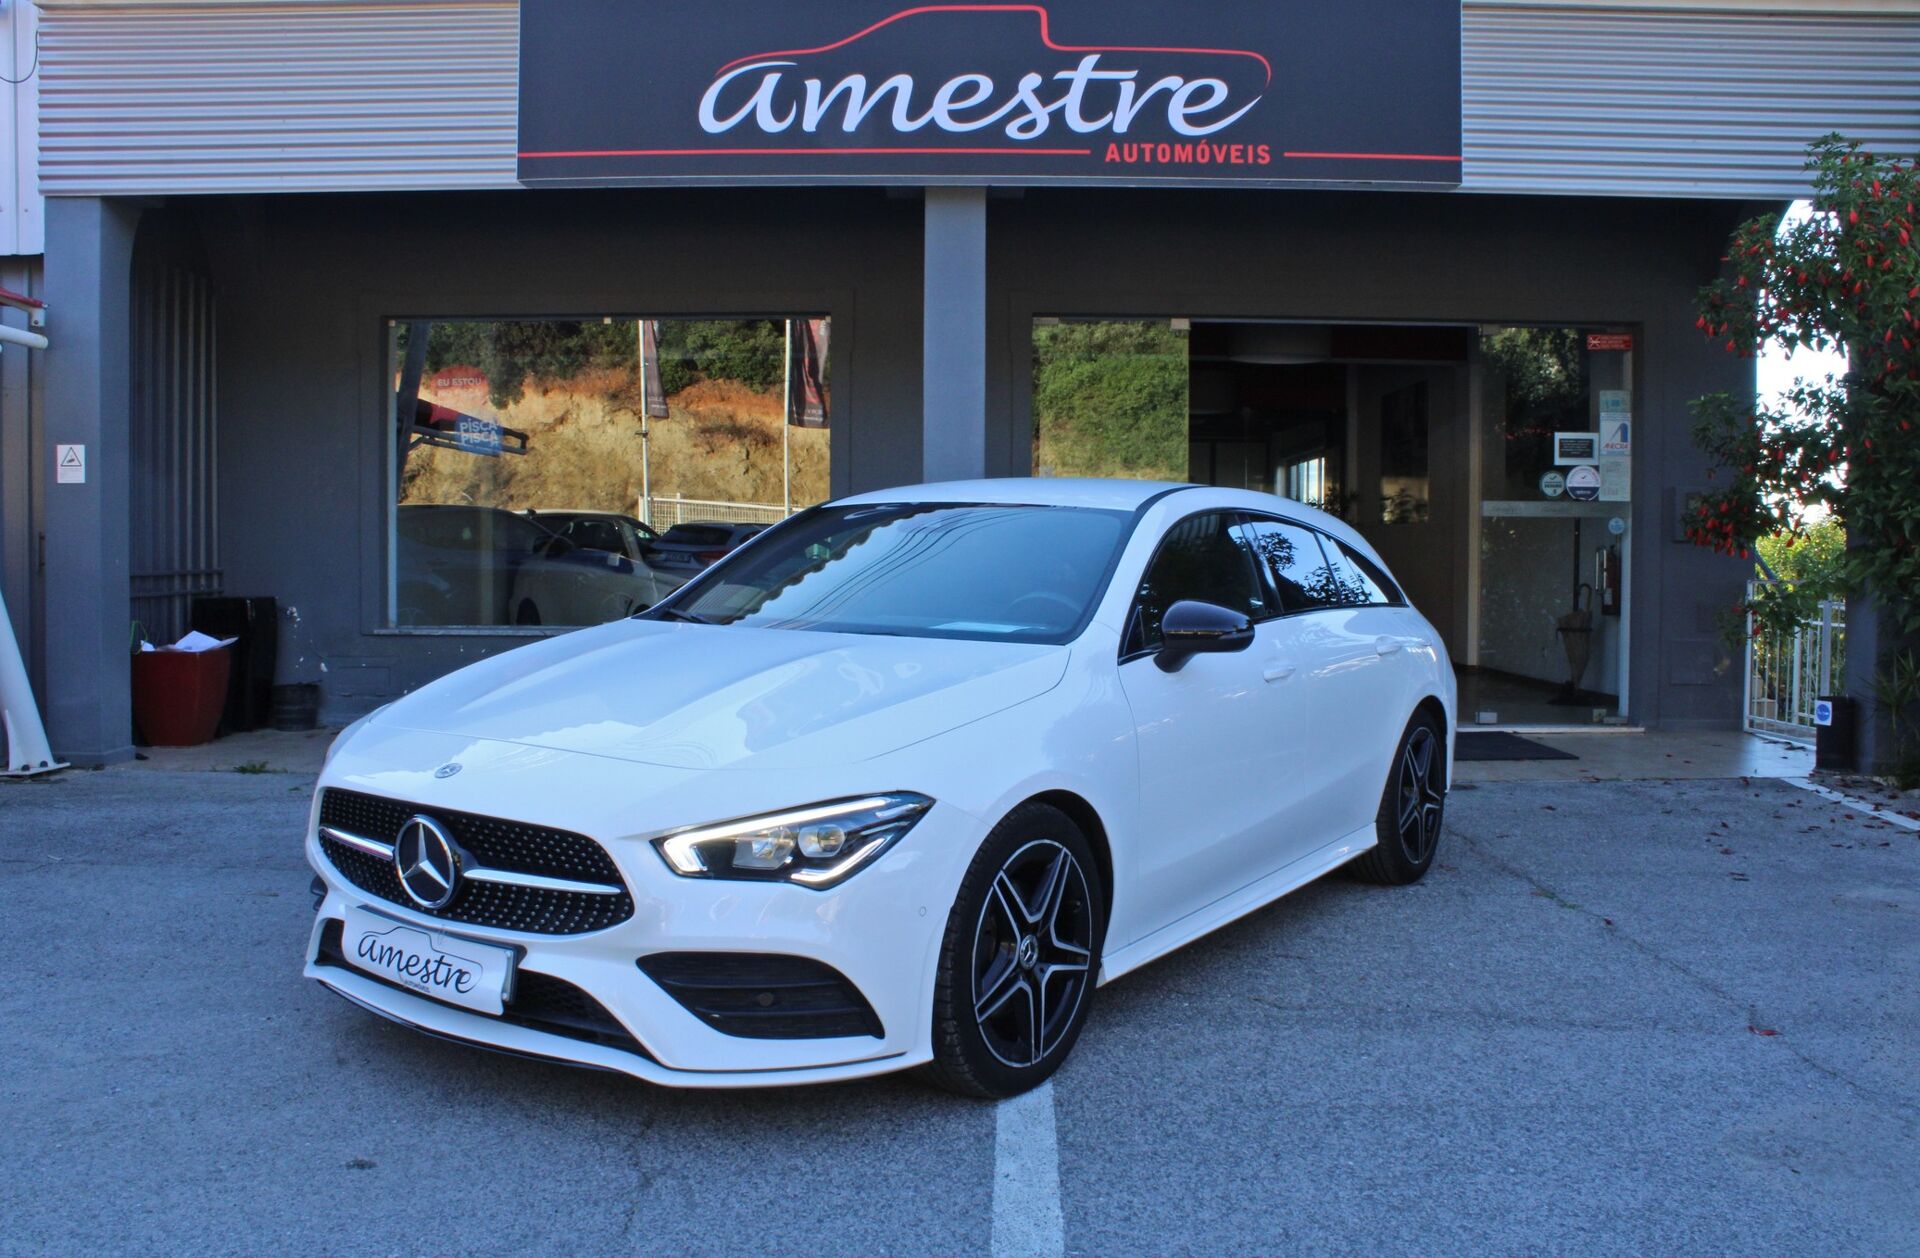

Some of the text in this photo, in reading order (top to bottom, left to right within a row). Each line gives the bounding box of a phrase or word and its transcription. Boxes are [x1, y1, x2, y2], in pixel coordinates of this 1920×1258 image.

[698, 54, 1263, 140] amestre
[1104, 140, 1271, 164] AUTOMÓVEIS
[452, 377, 482, 386] ESTOU
[357, 934, 473, 993] amestre
